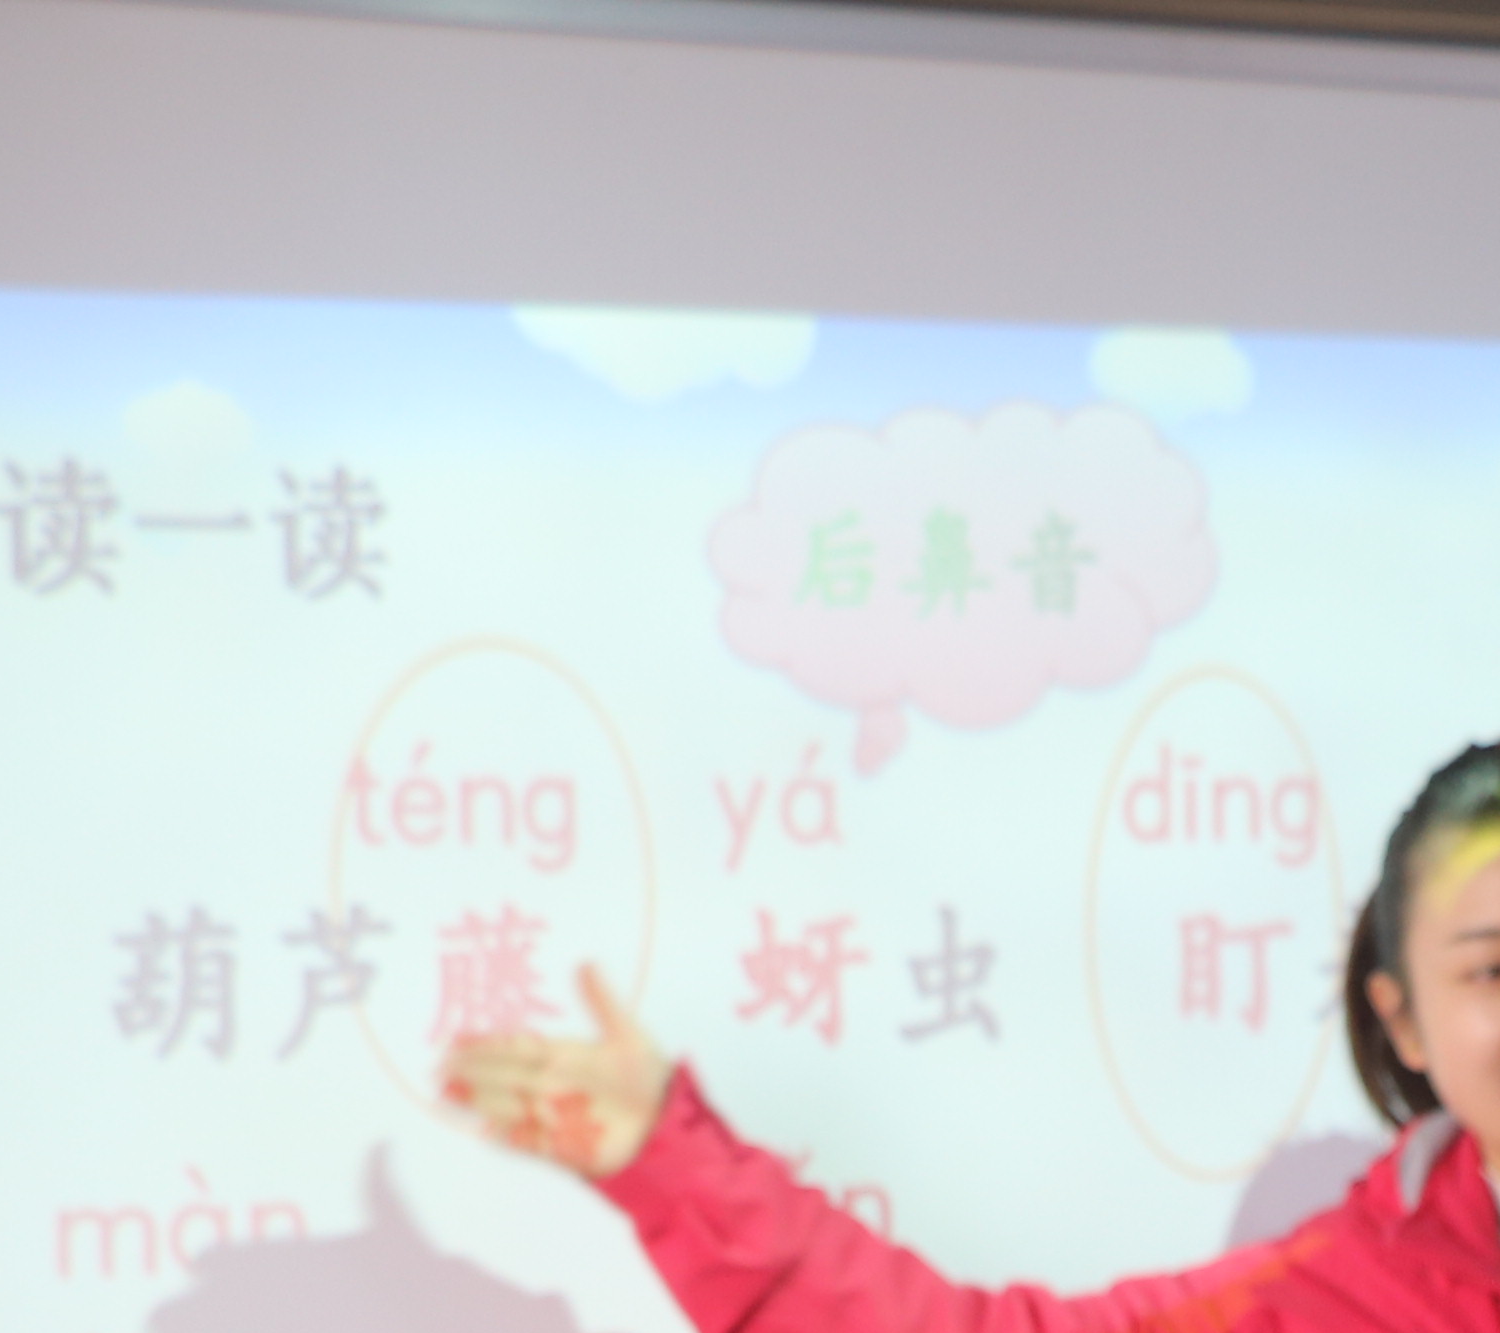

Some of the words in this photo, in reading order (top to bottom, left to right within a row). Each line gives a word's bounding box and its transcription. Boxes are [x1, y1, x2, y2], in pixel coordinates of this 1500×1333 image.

[793, 503, 1100, 622] 后鼻音
[346, 738, 577, 874] téng
[713, 740, 843, 874] yá
[1120, 738, 1322, 872] dīng
[111, 904, 565, 1062] 葫芦藤
[736, 904, 1004, 1044] 蚜虫
[1176, 908, 1356, 1032] 盯
